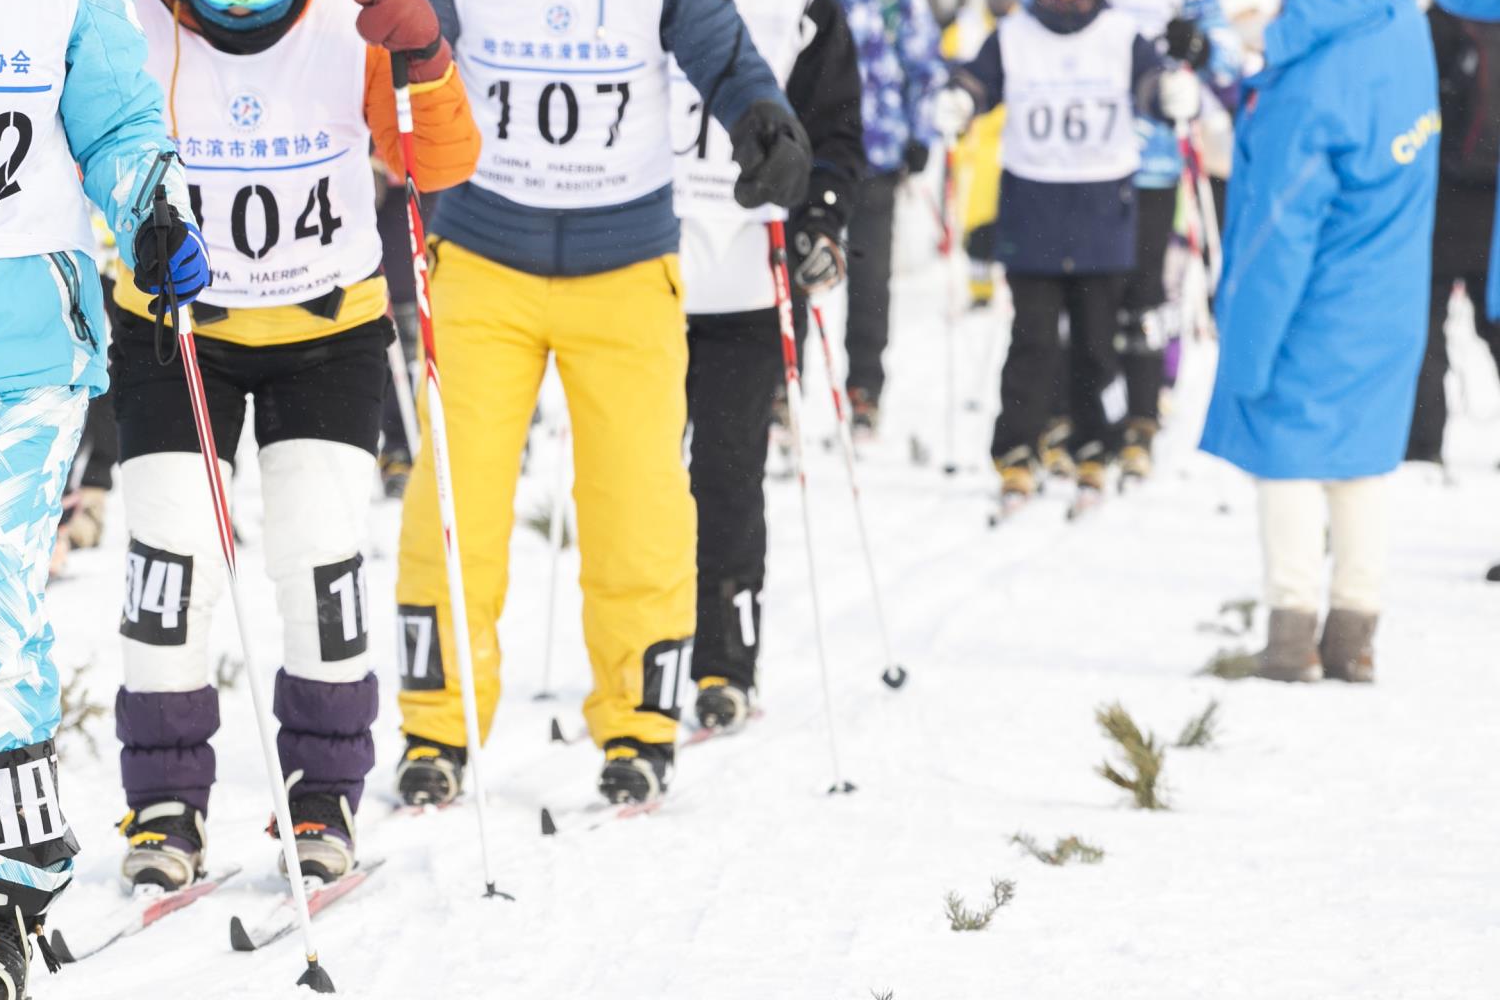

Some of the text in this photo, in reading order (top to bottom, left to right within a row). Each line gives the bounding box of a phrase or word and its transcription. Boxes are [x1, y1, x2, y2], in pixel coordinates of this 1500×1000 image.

[484, 38, 629, 60] 哈尔滨市滑雪协会
[488, 80, 631, 148] 107
[1027, 98, 1119, 146] 067
[492, 154, 531, 170] CHINA
[476, 169, 515, 185] AERBIN
[250, 265, 309, 283] HAERBIN
[733, 589, 763, 647] 1
